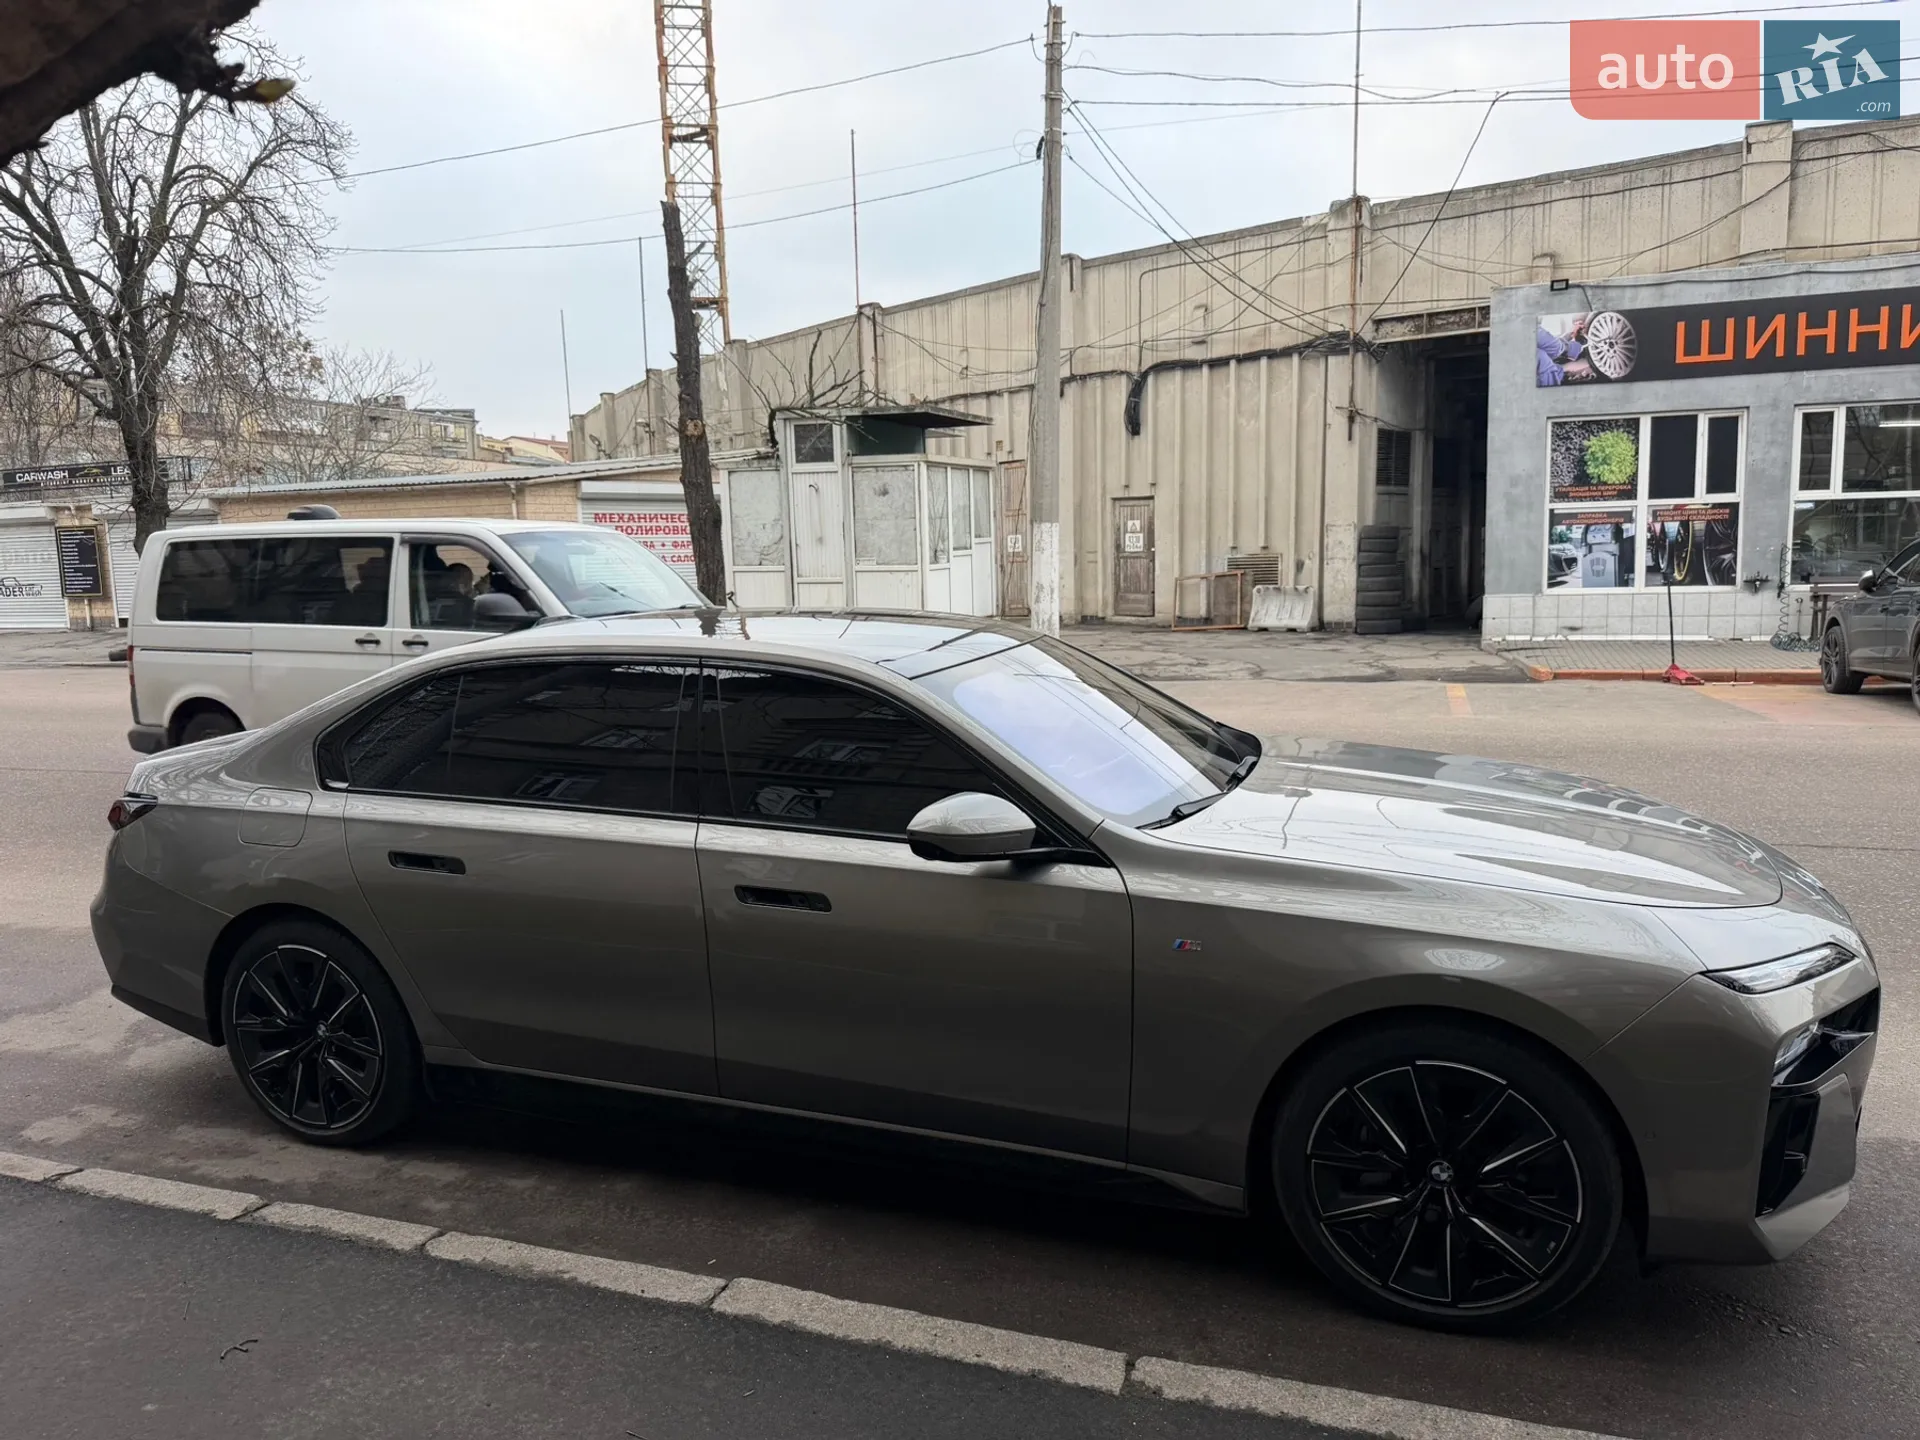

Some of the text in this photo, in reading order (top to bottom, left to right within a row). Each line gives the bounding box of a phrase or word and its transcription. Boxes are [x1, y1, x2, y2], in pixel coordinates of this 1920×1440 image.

[15, 470, 69, 482] CARWASH
[110, 466, 131, 475] LEA
[615, 525, 691, 535] ПОЛИРОВК
